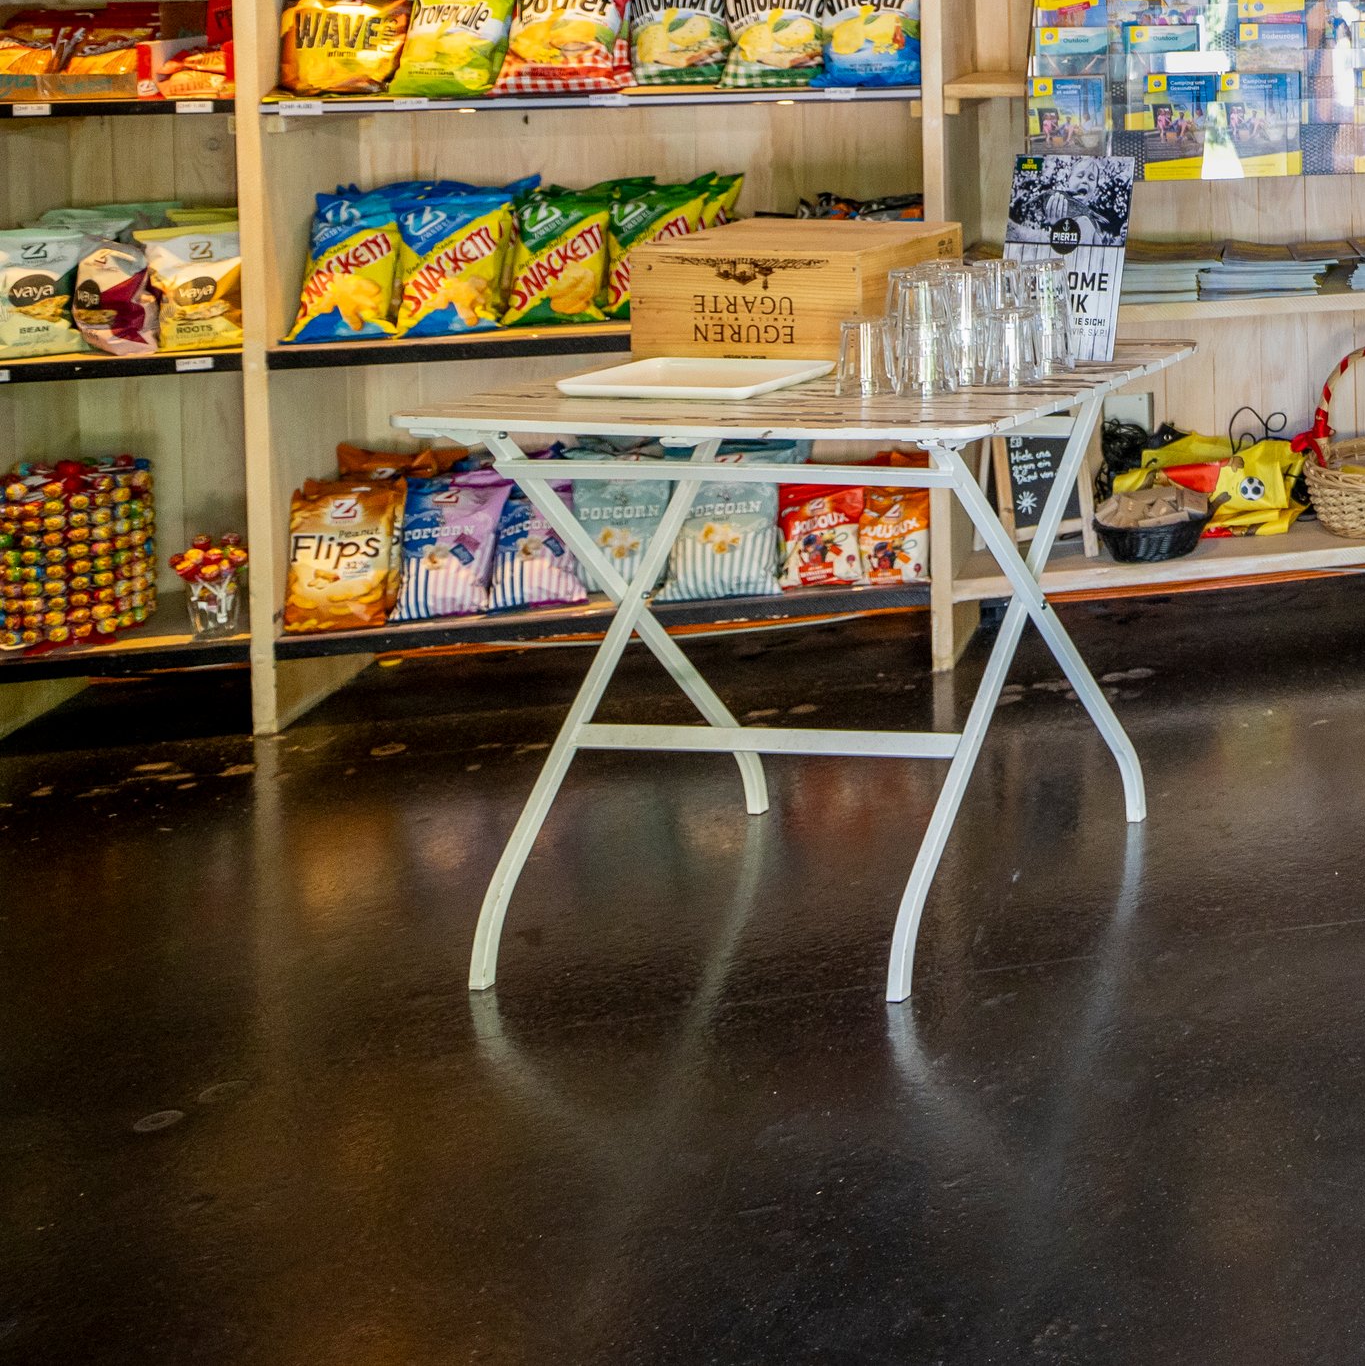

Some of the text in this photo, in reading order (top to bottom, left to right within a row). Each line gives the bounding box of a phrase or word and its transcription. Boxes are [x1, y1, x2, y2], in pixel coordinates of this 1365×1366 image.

[295, 12, 381, 51] WAVE
[1062, 36, 1090, 44] Outdoor
[1152, 35, 1179, 43] Outdoor
[1056, 83, 1082, 91] Camping
[1170, 80, 1194, 88] Camping
[402, 226, 497, 317] SNACKETTI
[511, 223, 604, 311] SNACKETTI
[12, 283, 55, 301] vaya
[77, 290, 99, 309] vaya
[178, 284, 215, 301] vaya
[693, 294, 795, 315] UGARTE
[19, 325, 50, 334] BEAN
[176, 324, 213, 334] ROOTS
[1084, 318, 1106, 326] SICH!
[693, 324, 795, 344] EGUREN
[404, 524, 476, 542] POPCORN
[291, 535, 382, 570] Flips
